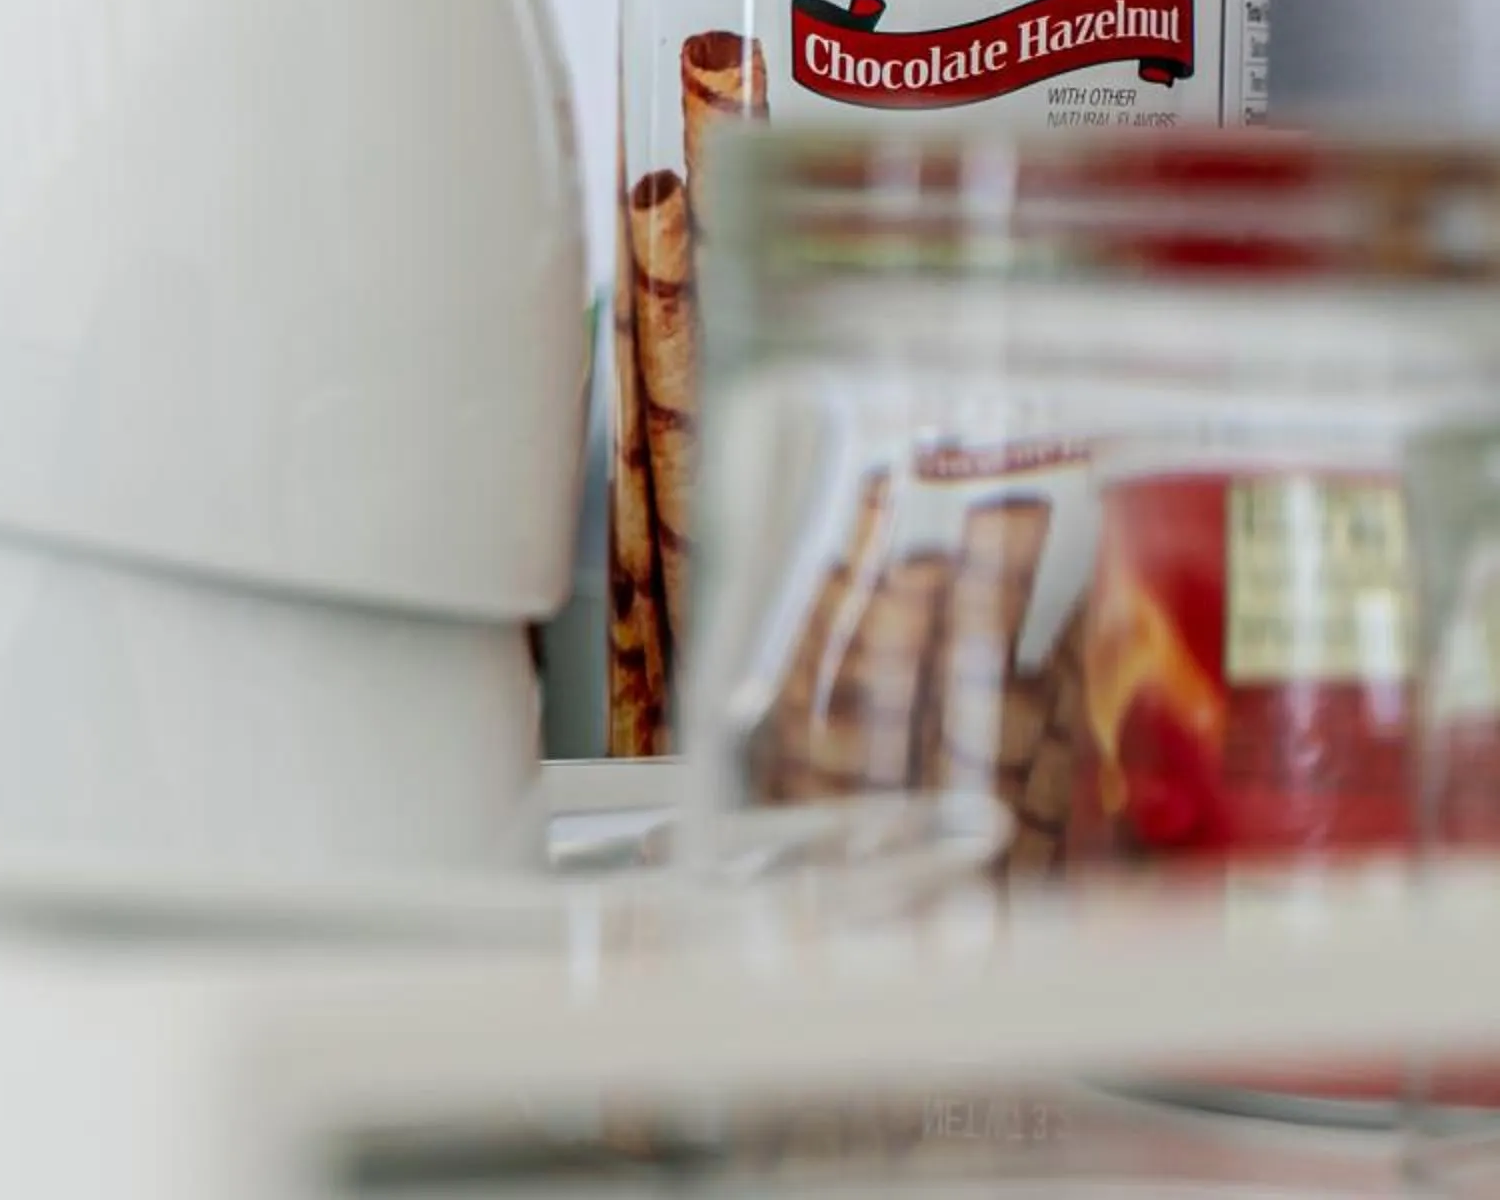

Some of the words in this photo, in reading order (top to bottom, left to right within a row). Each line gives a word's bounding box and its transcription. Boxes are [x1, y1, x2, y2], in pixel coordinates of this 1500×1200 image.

[803, 31, 1010, 92] Chocolate
[1048, 87, 1087, 106] WITH
[1088, 87, 1138, 107] OTHER
